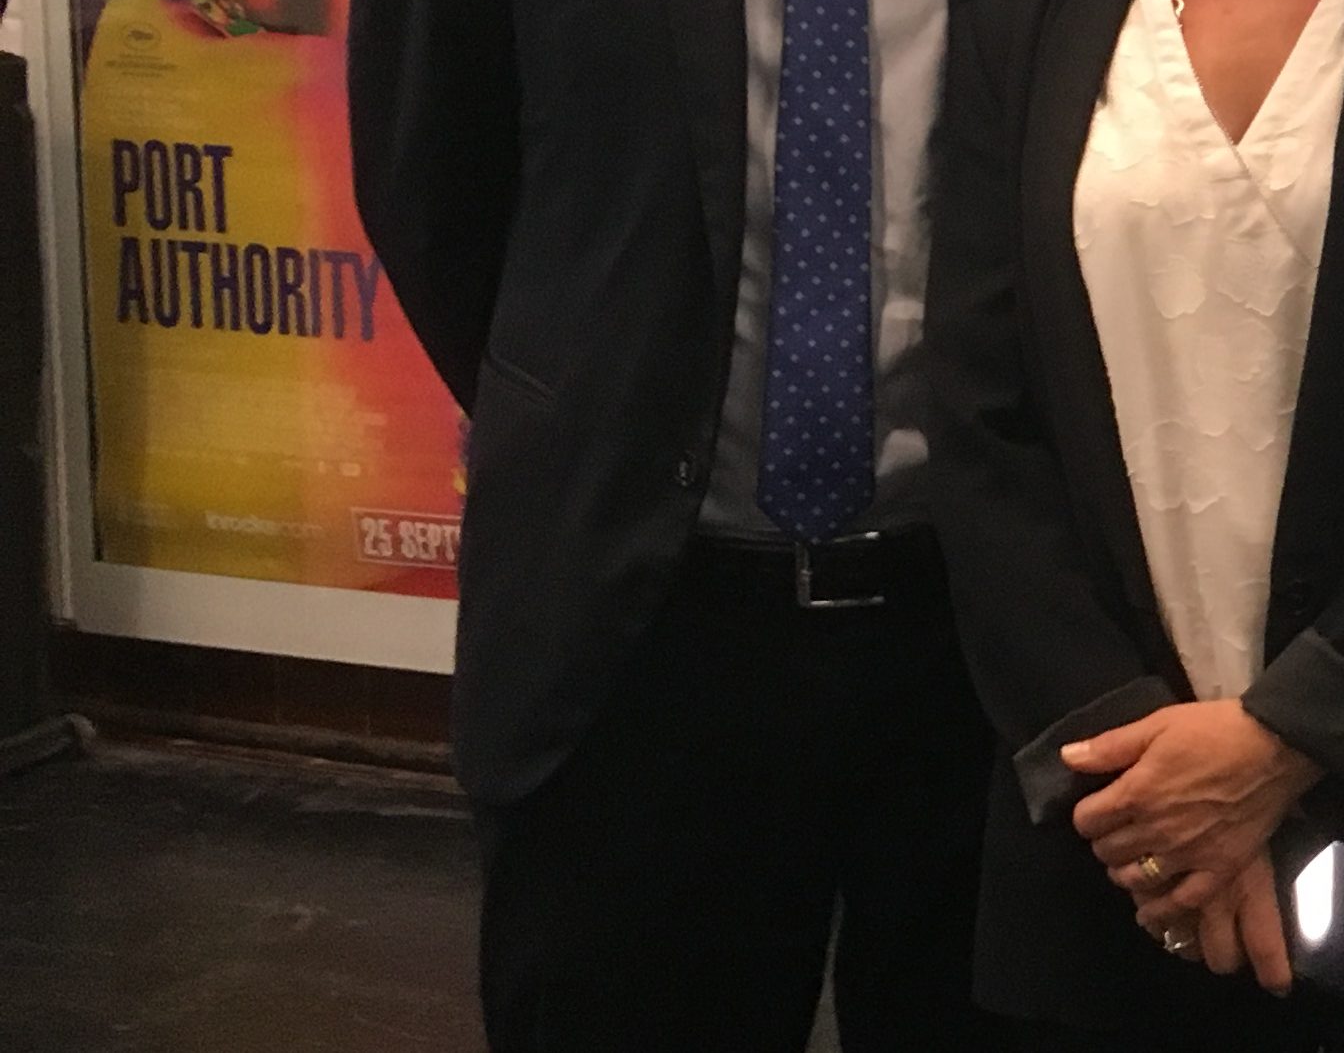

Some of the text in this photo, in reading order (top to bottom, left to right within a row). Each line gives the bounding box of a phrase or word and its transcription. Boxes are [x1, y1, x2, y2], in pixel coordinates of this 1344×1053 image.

[111, 138, 234, 234] PORT
[115, 237, 384, 342] AUTHORITY
[360, 516, 461, 563] 25 SEPT
